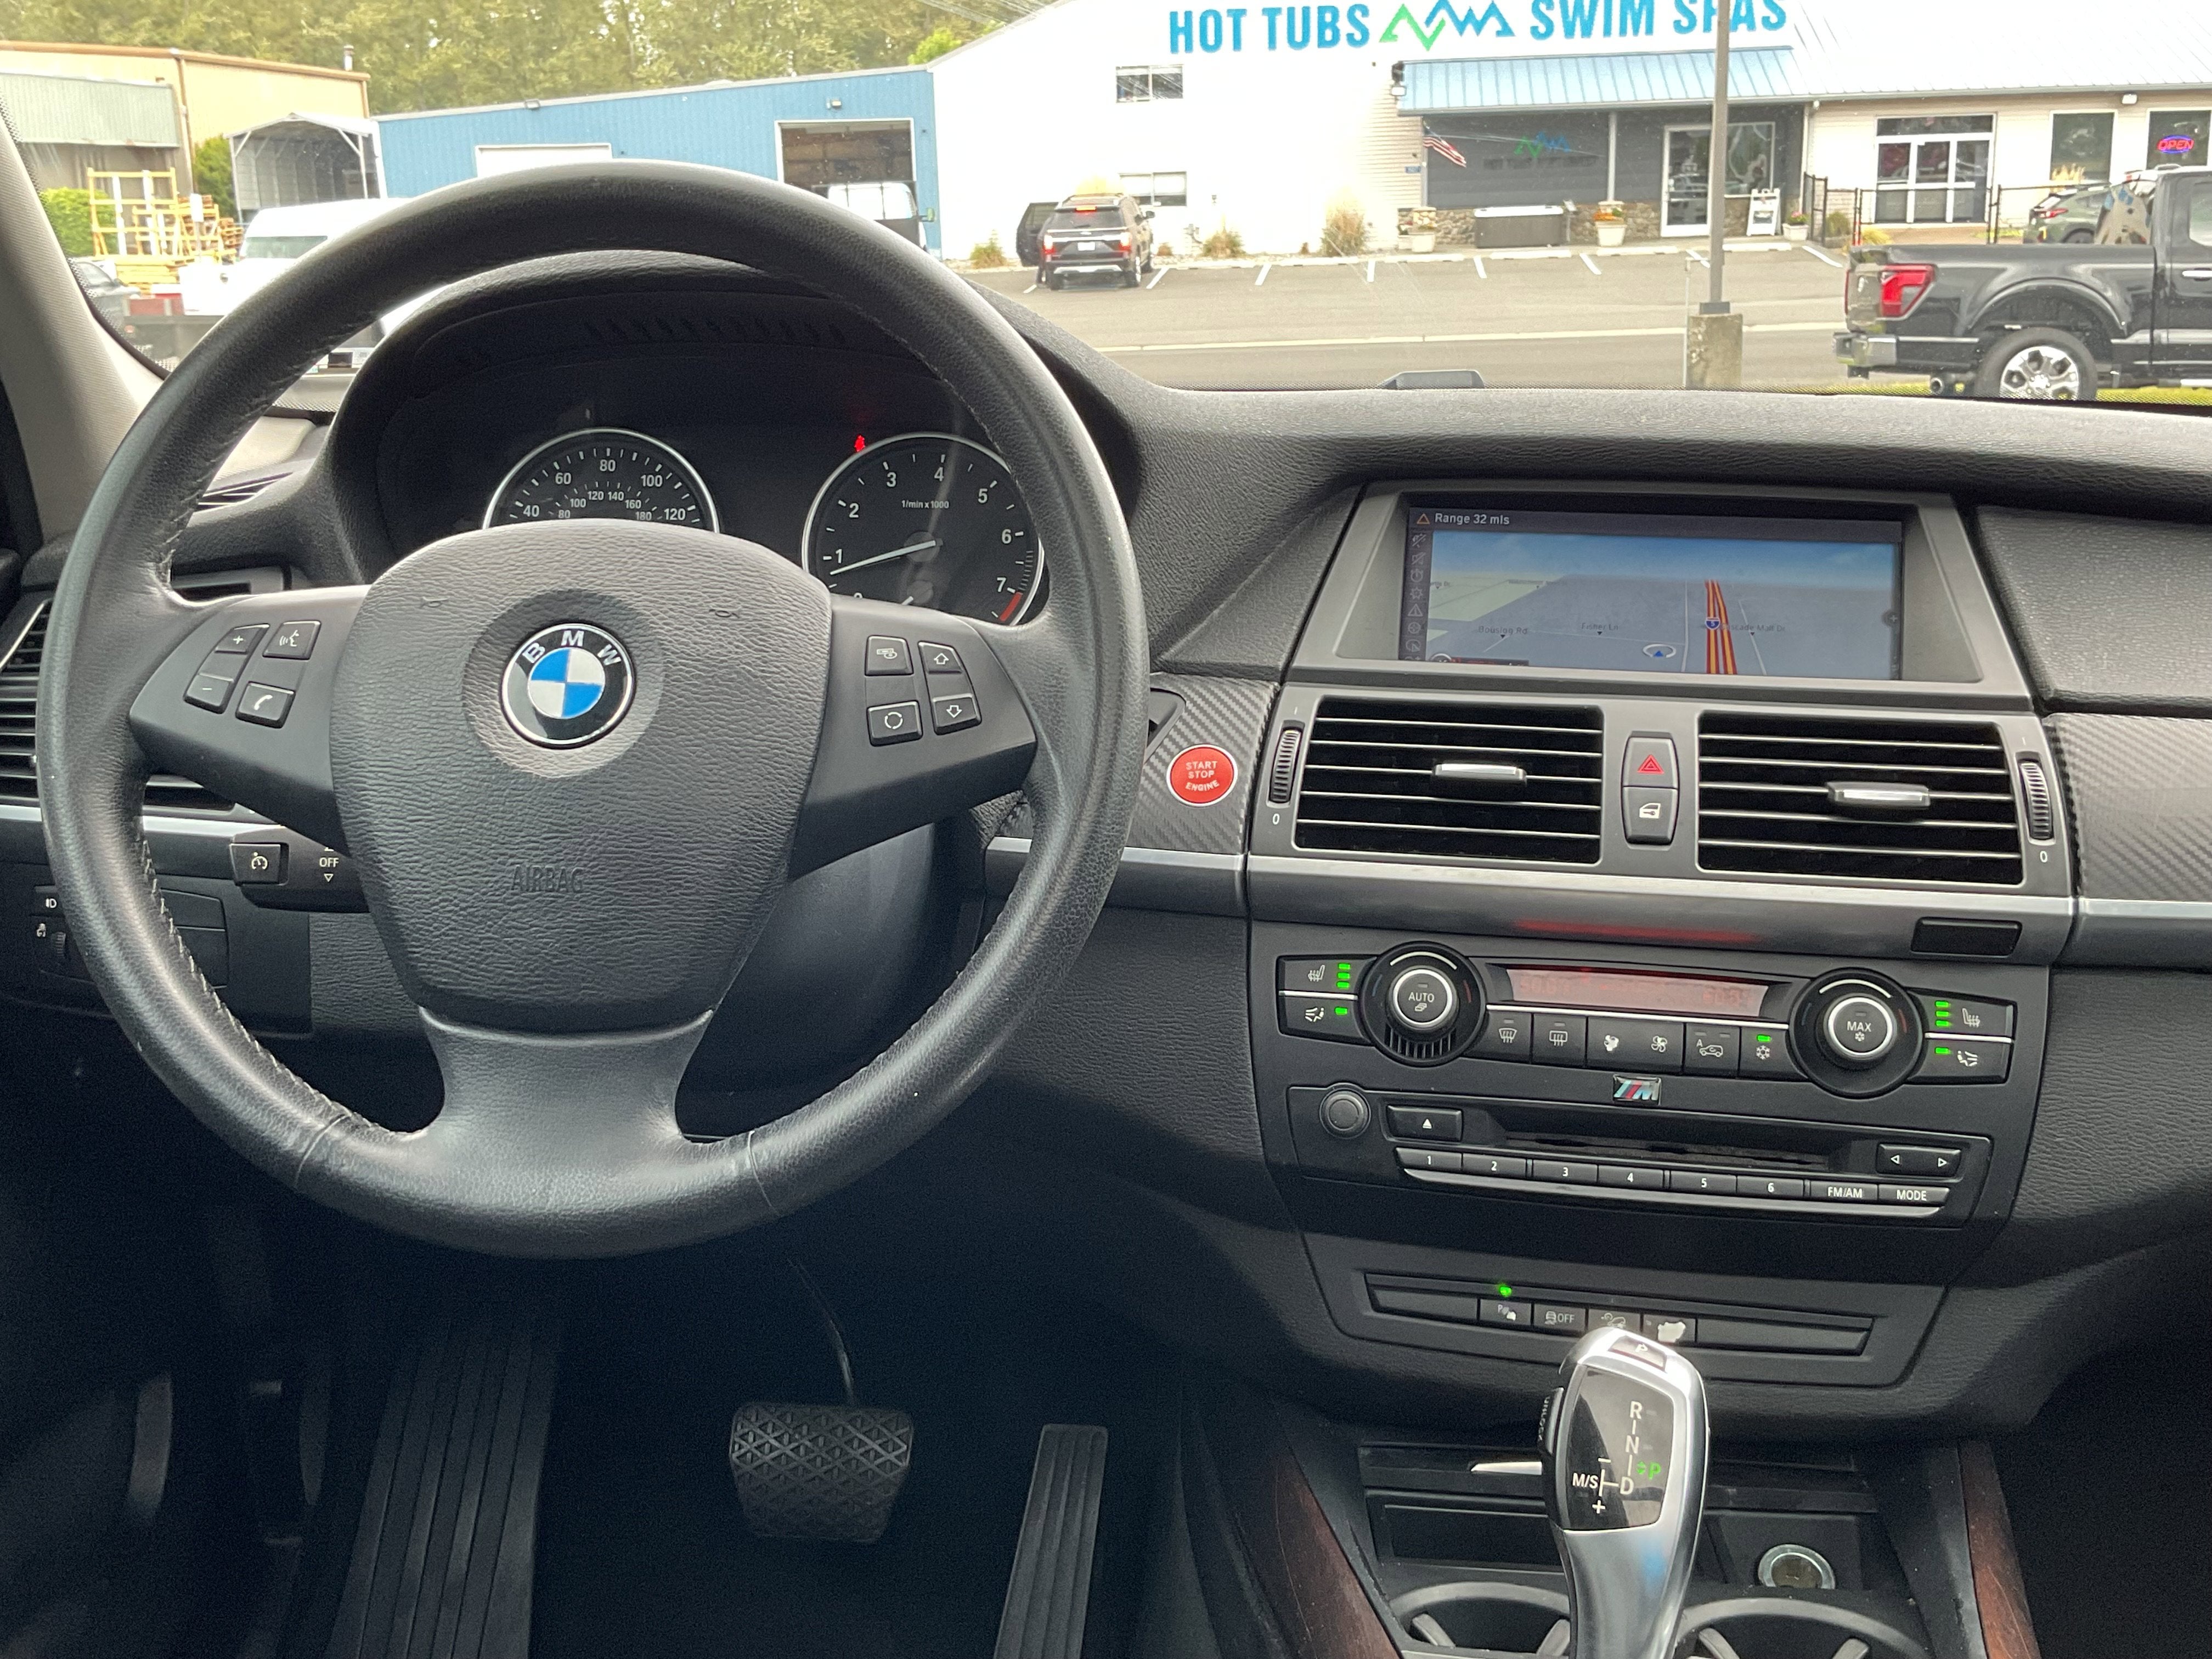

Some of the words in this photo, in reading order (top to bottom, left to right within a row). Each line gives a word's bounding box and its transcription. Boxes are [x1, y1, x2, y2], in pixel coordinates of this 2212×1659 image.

[1530, 0, 1654, 41] SWIM
[1170, 8, 1248, 54] HOT
[1262, 4, 1369, 52] TUBS
[2157, 138, 2194, 151] OPEN
[599, 459, 616, 472] 80
[555, 472, 572, 485] 60
[887, 472, 897, 488] 3
[934, 467, 945, 482] 4
[640, 475, 663, 487] 100
[588, 490, 604, 501] 120
[607, 491, 624, 501] 140
[978, 488, 988, 504] 5
[570, 498, 586, 508] 100
[625, 499, 642, 509] 160
[901, 500, 923, 509] 1/min
[930, 500, 950, 509] 1000
[523, 504, 539, 517] 40
[558, 510, 571, 519] 80
[635, 511, 652, 521] 180
[664, 508, 686, 521] 120
[849, 503, 859, 518] 2
[1435, 512, 1470, 526] Range
[1473, 514, 1487, 524] 32
[1489, 515, 1510, 525] mls
[1001, 529, 1012, 544] 6
[835, 549, 843, 563] 1
[996, 577, 1007, 592] 7
[522, 630, 622, 666] BMW
[1185, 760, 1218, 770] START
[1188, 770, 1215, 779] STOP
[1185, 780, 1220, 792] ENGINE
[319, 856, 340, 868] OFF
[510, 864, 585, 893] AIRBAG
[1408, 991, 1435, 1003] AUTO
[1847, 1020, 1872, 1032] MAX
[1426, 1155, 1432, 1165] 1
[1491, 1161, 1497, 1171] 2
[1562, 1167, 1568, 1177] 3
[1627, 1172, 1634, 1183] 4
[1701, 1177, 1707, 1188] 5
[1768, 1182, 1774, 1193] 6
[1827, 1186, 1863, 1199] FM/AM
[1897, 1189, 1927, 1201] MODE
[1558, 1313, 1575, 1323] OFF
[1634, 1344, 1648, 1354] P
[1629, 1401, 1643, 1419] R
[1626, 1435, 1640, 1454] N
[1648, 1462, 1662, 1480] P
[1572, 1472, 1599, 1489] M/S
[1620, 1476, 1634, 1495] D
